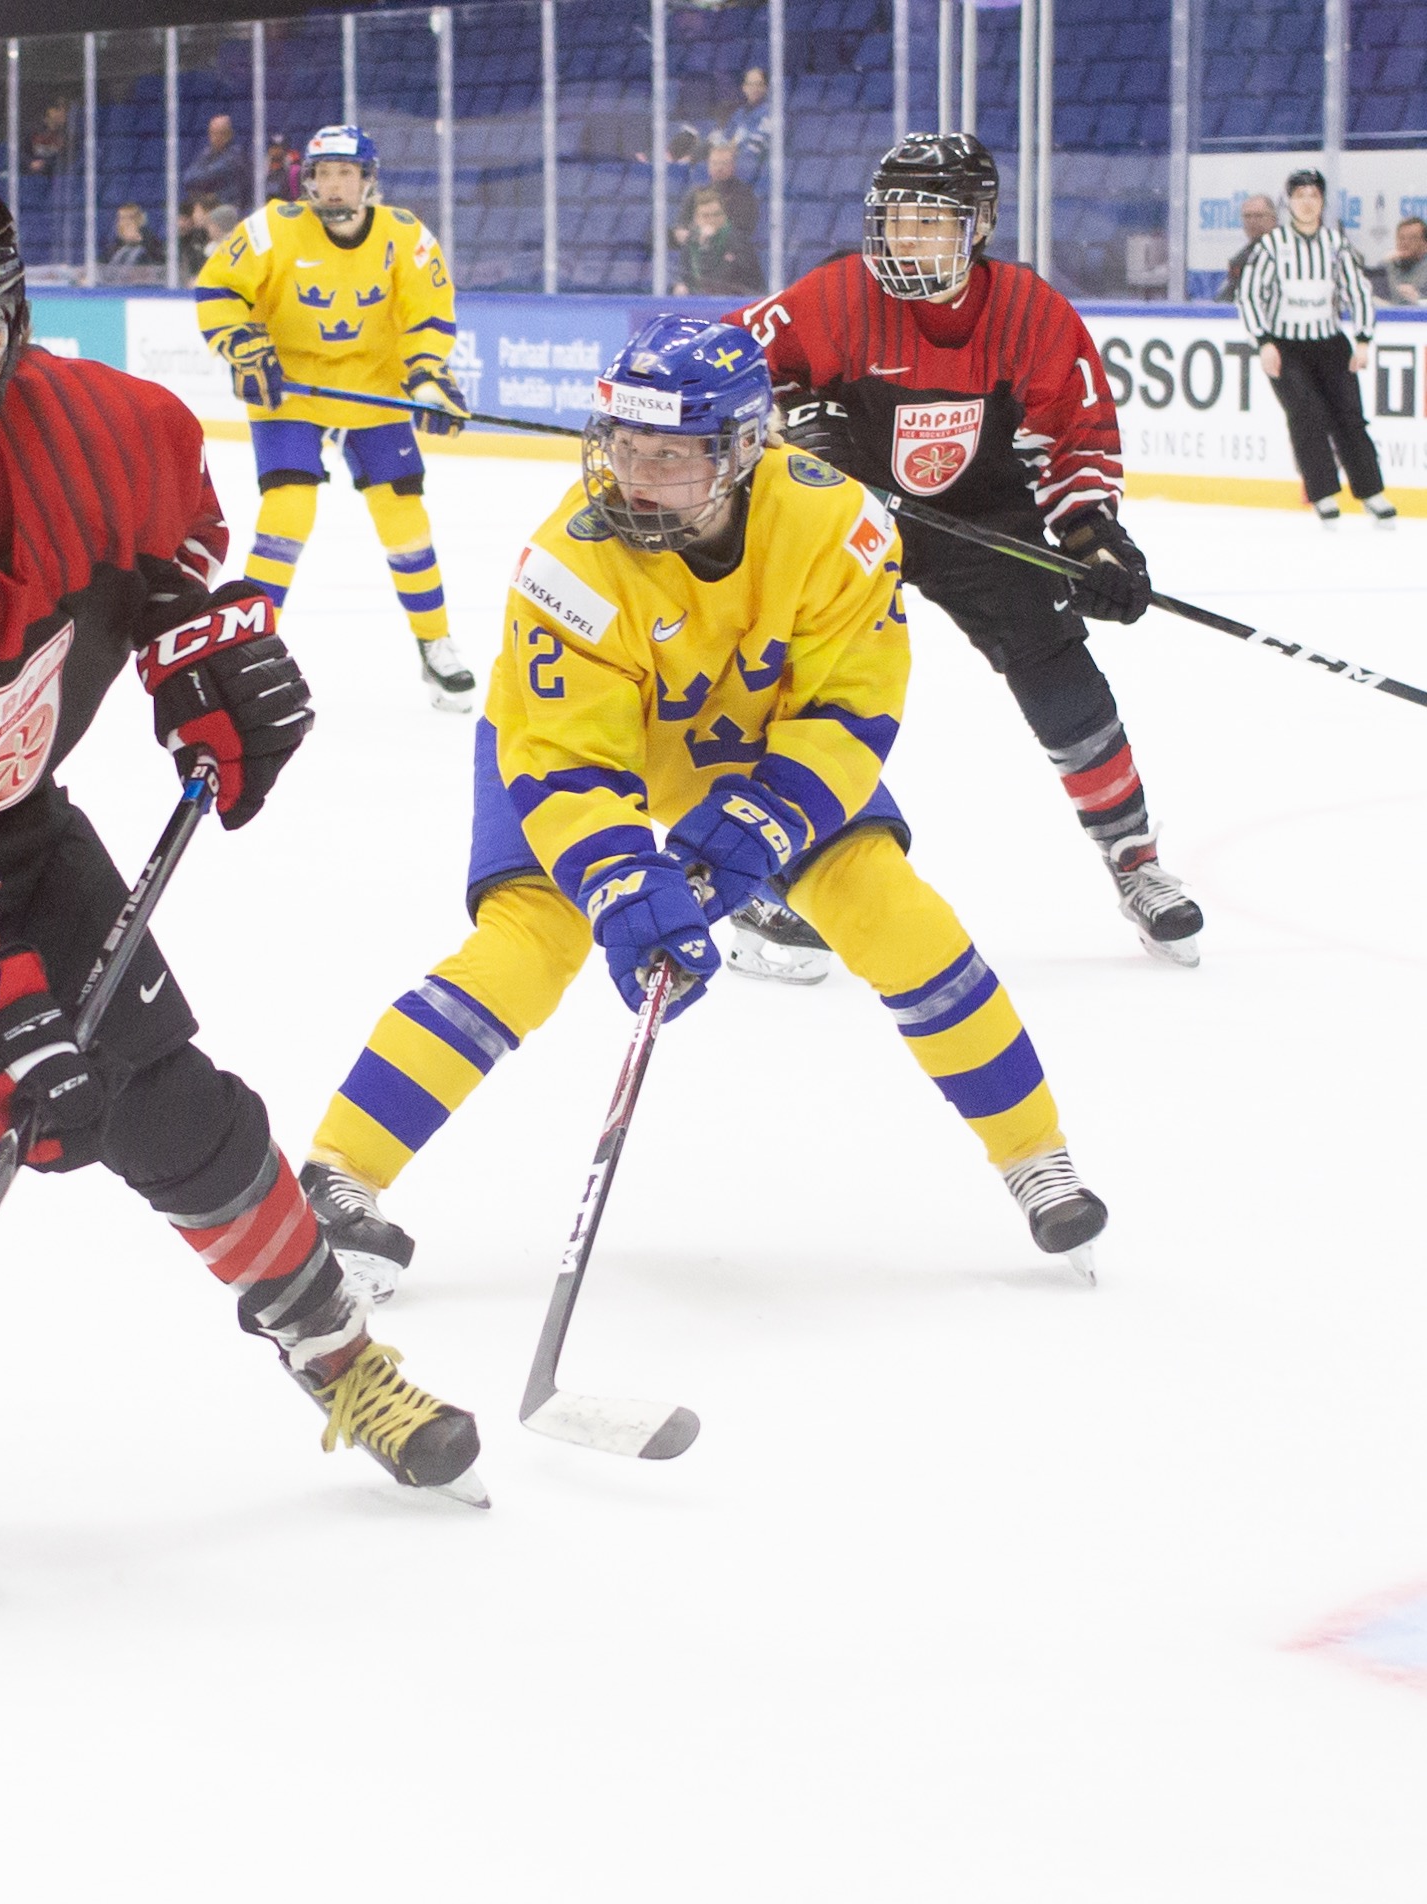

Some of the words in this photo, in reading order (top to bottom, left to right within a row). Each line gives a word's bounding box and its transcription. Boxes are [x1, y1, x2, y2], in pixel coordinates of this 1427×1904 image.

[743, 290, 791, 347] 15
[614, 406, 643, 421] SPEL
[615, 391, 674, 413] SVENSKA
[904, 407, 976, 428] JAPAN
[1141, 430, 1206, 458] SINCE
[1221, 433, 1269, 462] 1853
[522, 575, 562, 613] ENSKA
[563, 609, 594, 637] SPEL
[1247, 629, 1388, 689] CCM
[103, 855, 163, 953] TRUE
